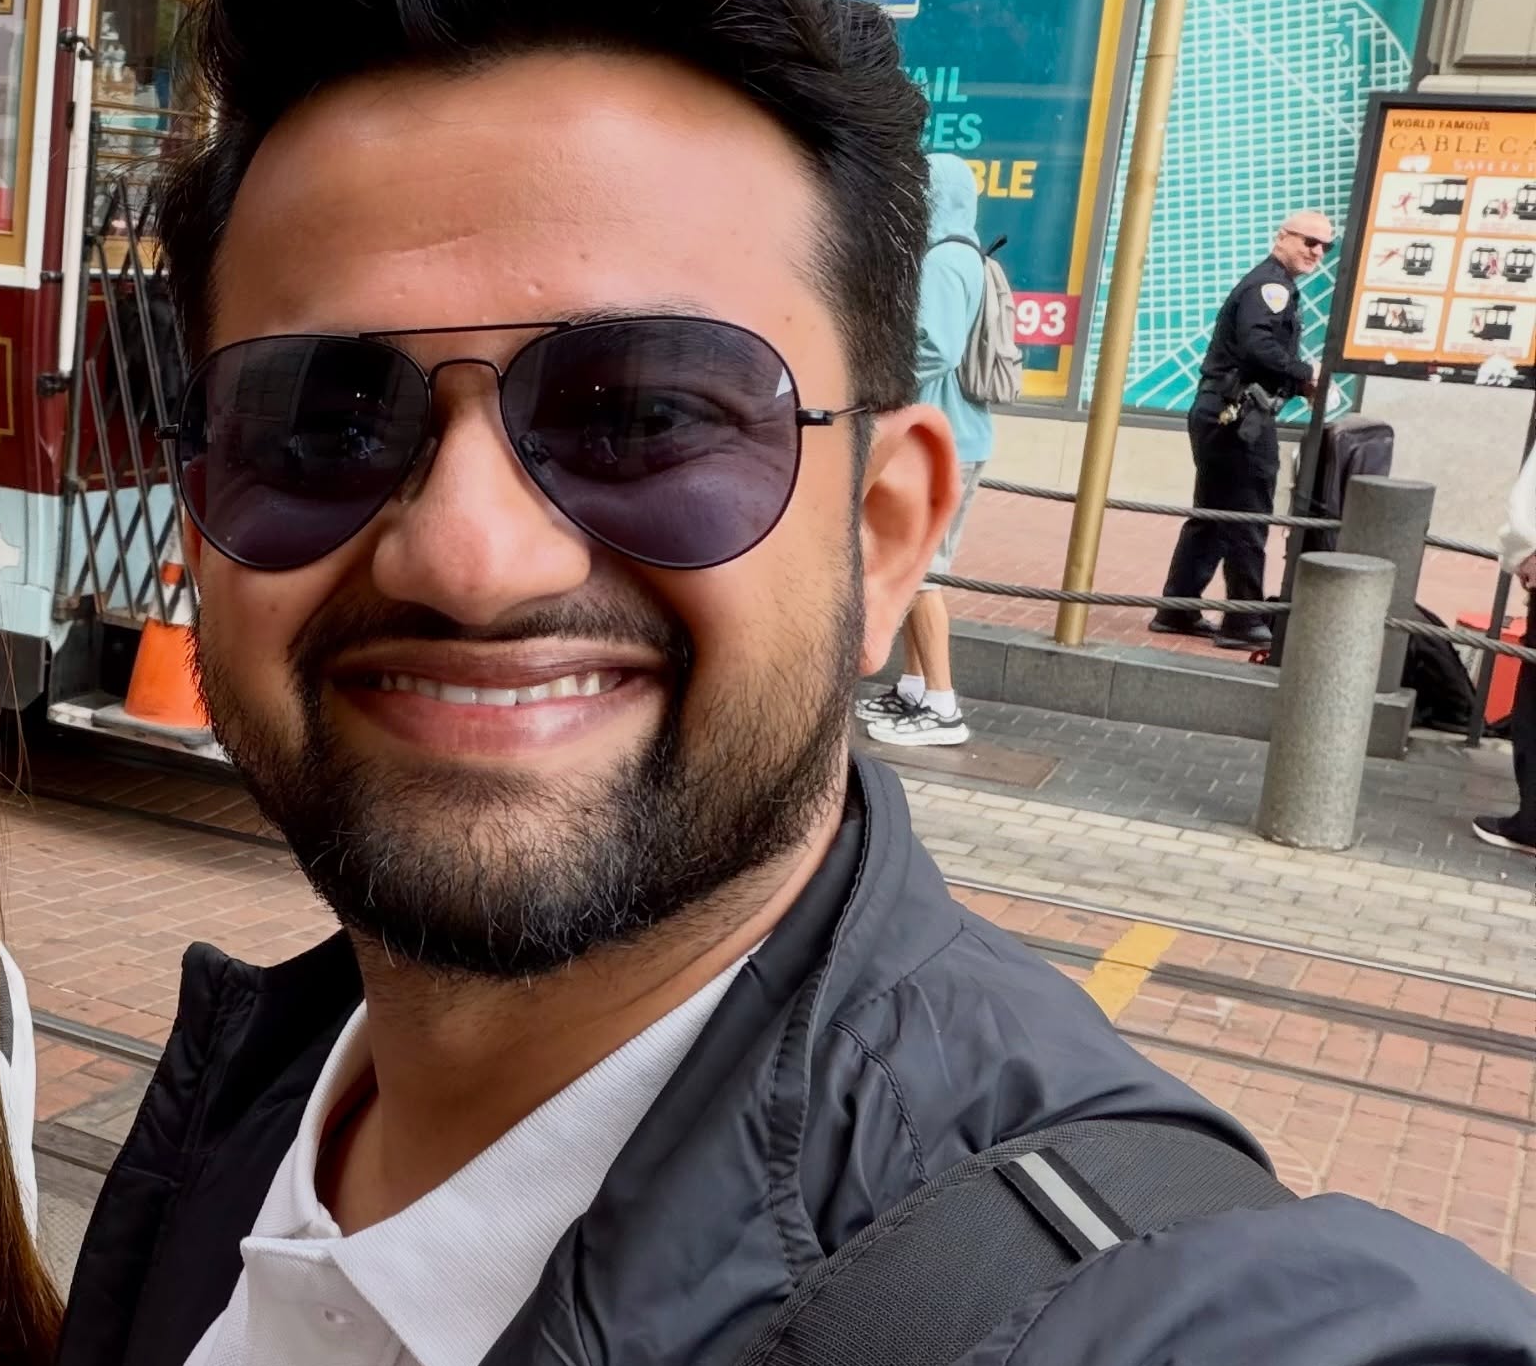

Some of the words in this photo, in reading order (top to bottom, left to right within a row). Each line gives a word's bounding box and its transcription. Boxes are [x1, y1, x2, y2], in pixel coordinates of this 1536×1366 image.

[906, 66, 968, 104] AIL
[1392, 117, 1436, 130] WORLD
[1439, 119, 1491, 132] FAMOUS
[1388, 135, 1490, 154] CABLE
[1498, 135, 1536, 155] CA
[1014, 300, 1067, 338] 93
